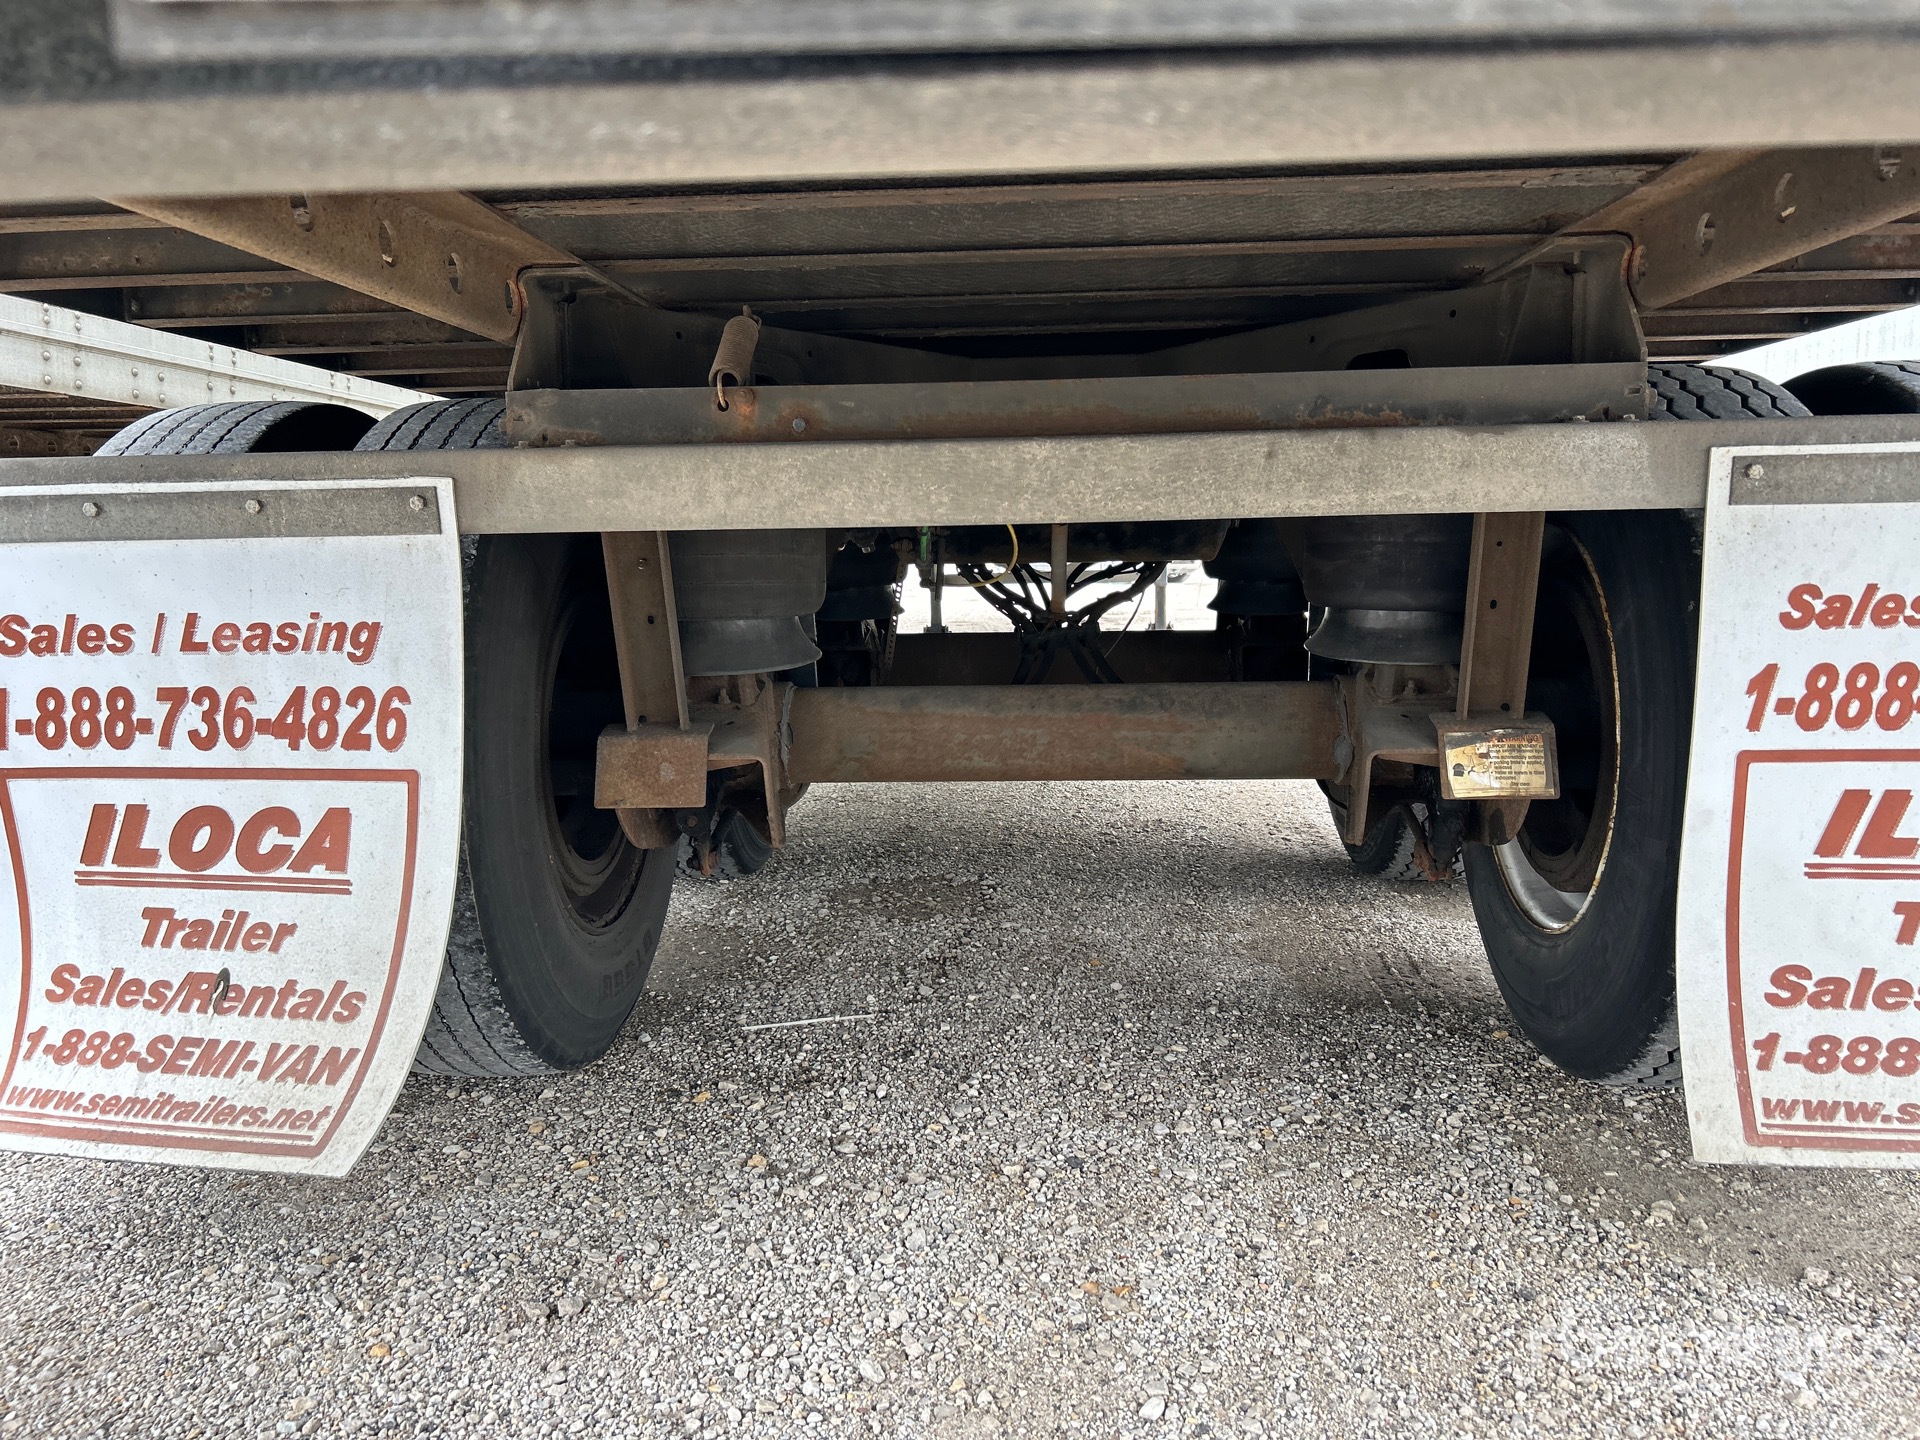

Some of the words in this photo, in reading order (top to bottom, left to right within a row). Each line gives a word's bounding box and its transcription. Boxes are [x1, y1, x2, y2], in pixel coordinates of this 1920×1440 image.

[0, 614, 136, 657] Sales
[180, 612, 382, 666] Leasing
[79, 803, 352, 874] ILOCA
[140, 906, 298, 953] Trailer
[44, 963, 367, 1024] Sales/Rentals
[22, 1026, 361, 1086] 1-888-SEMI-VAN
[5, 1086, 334, 1132] www.semitrailers.net
